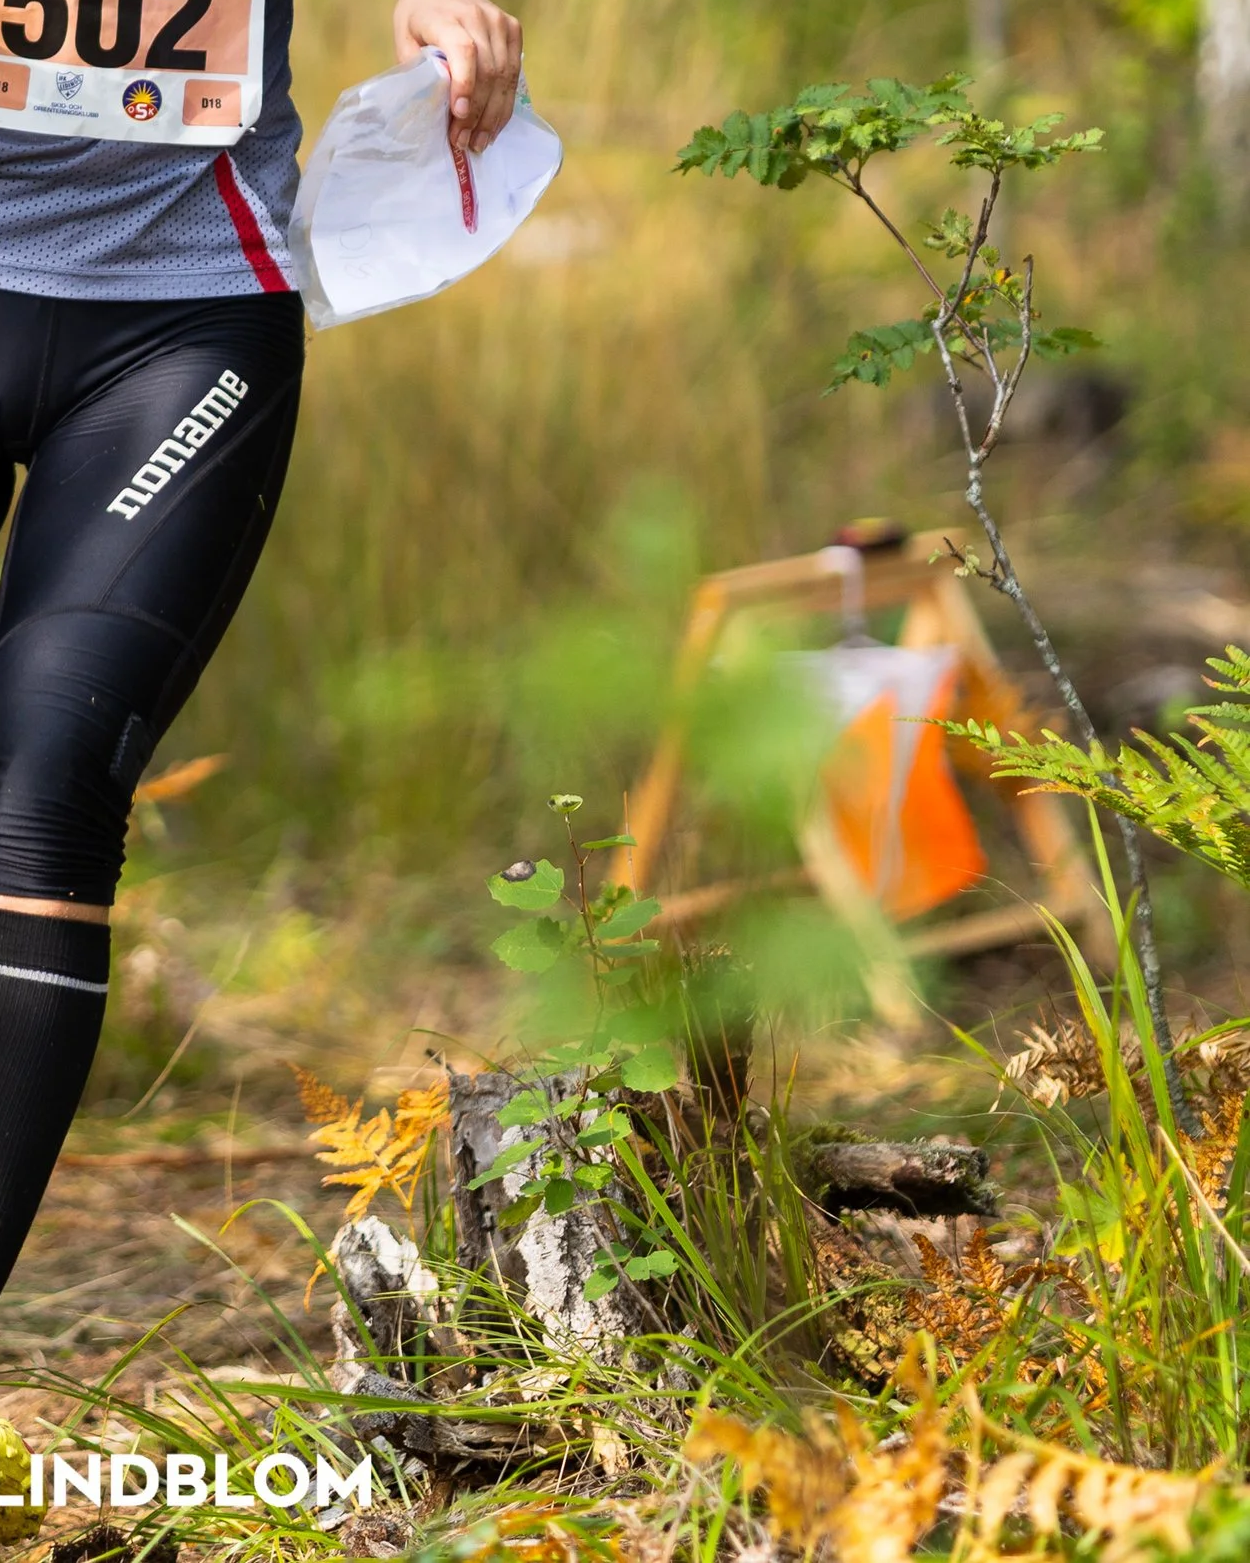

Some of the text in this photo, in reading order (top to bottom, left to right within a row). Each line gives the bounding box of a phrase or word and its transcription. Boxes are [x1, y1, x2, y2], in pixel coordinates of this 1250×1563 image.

[202, 97, 222, 109] D18
[457, 165, 468, 184] IFK
[106, 369, 249, 521] noname
